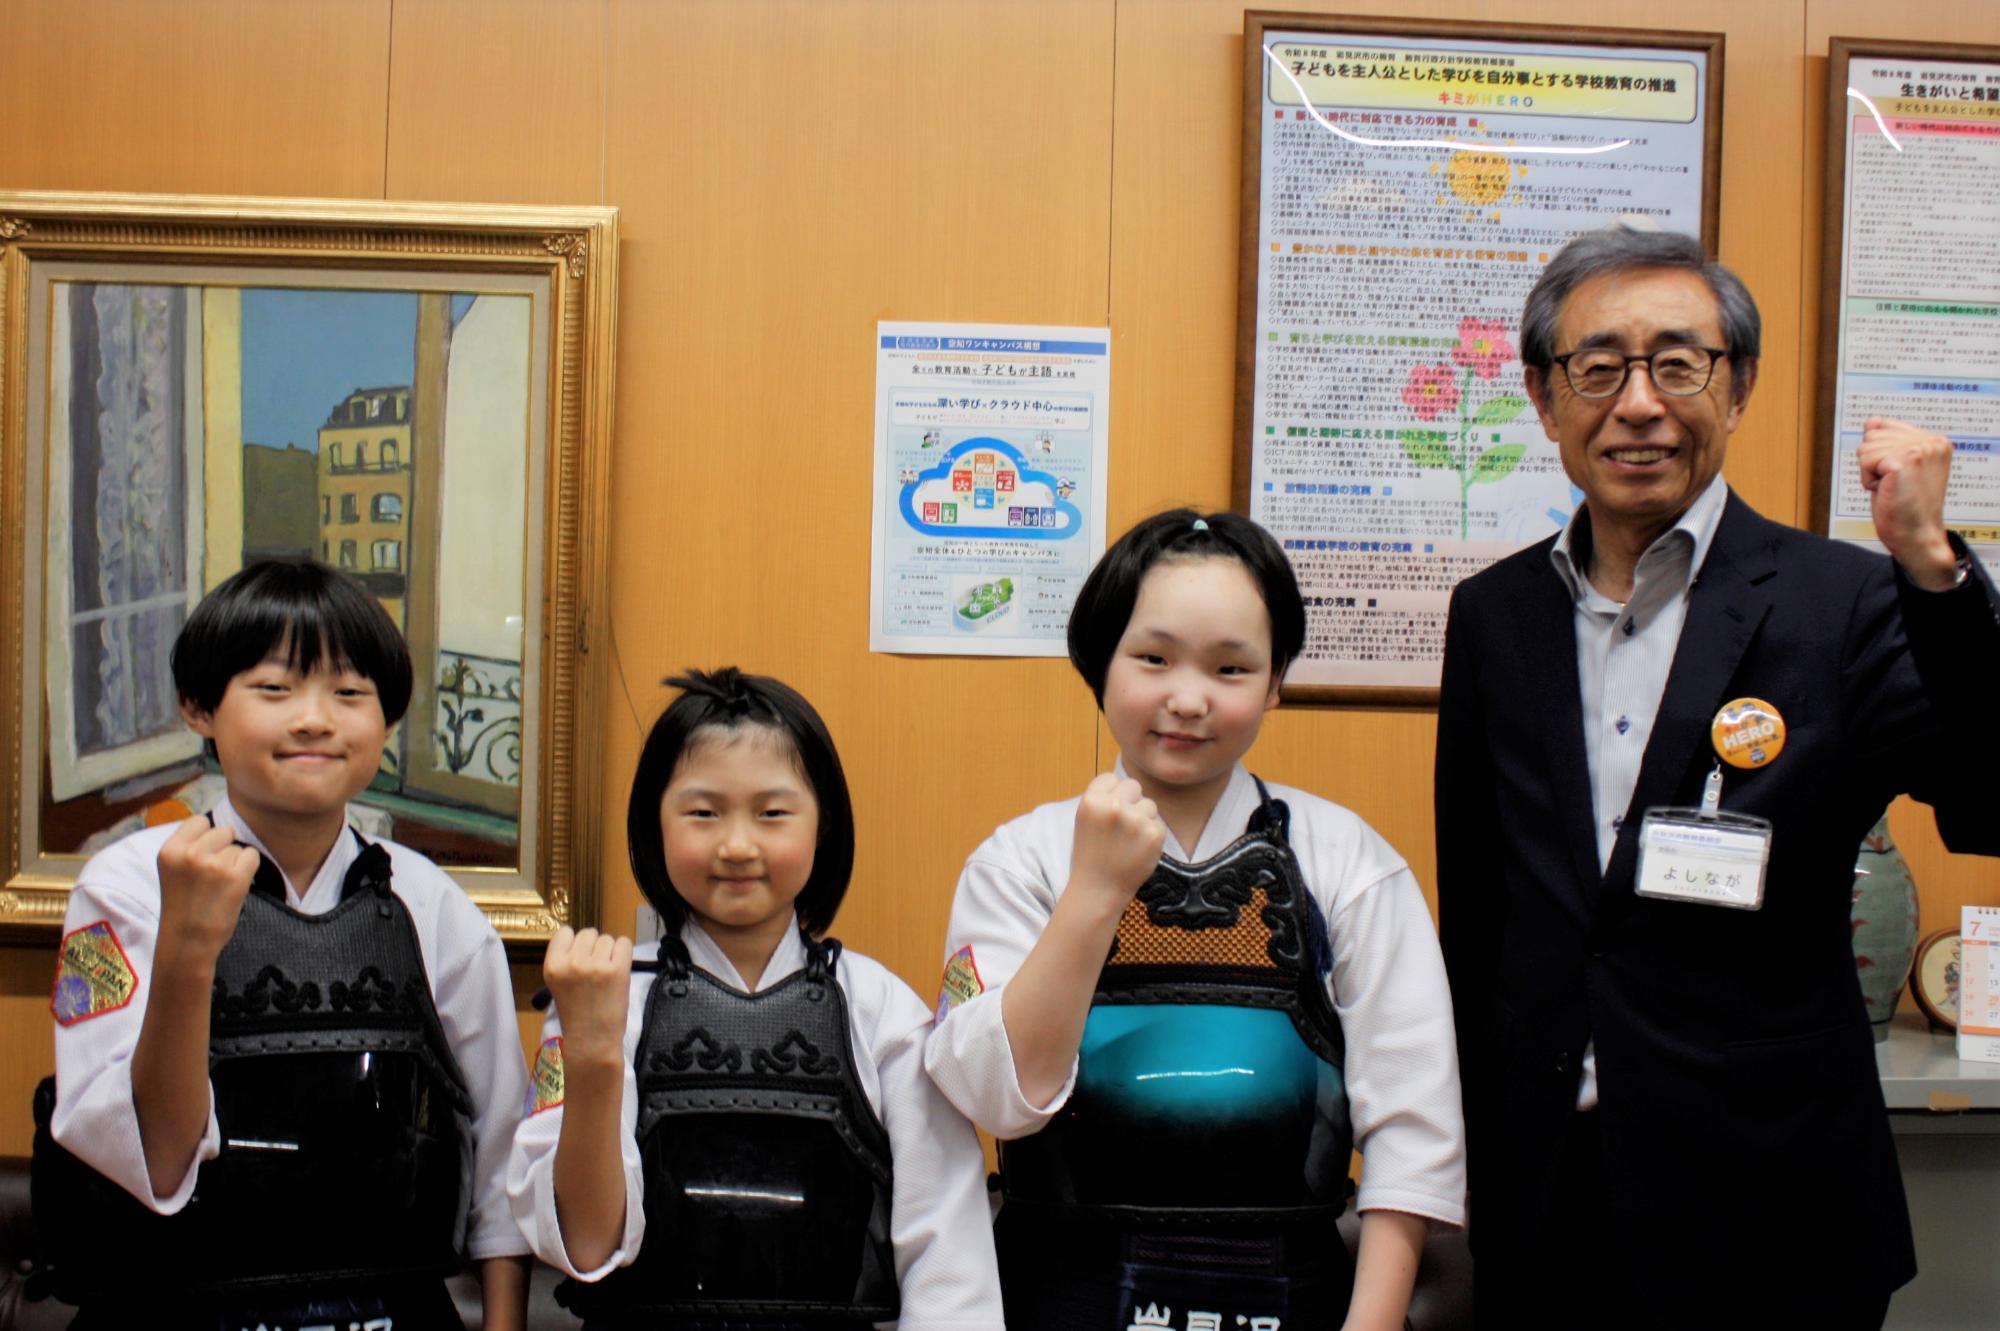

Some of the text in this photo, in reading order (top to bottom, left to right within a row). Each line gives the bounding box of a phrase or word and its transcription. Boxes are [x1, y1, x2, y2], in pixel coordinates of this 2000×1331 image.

[1291, 62, 1676, 92] 子どもを主人公とした学びを自分事とする学校教育の推進
[1900, 84, 1999, 102] 生きがいと希望
[1664, 866, 1741, 888] よしなが
[1970, 921, 1981, 936] 7
